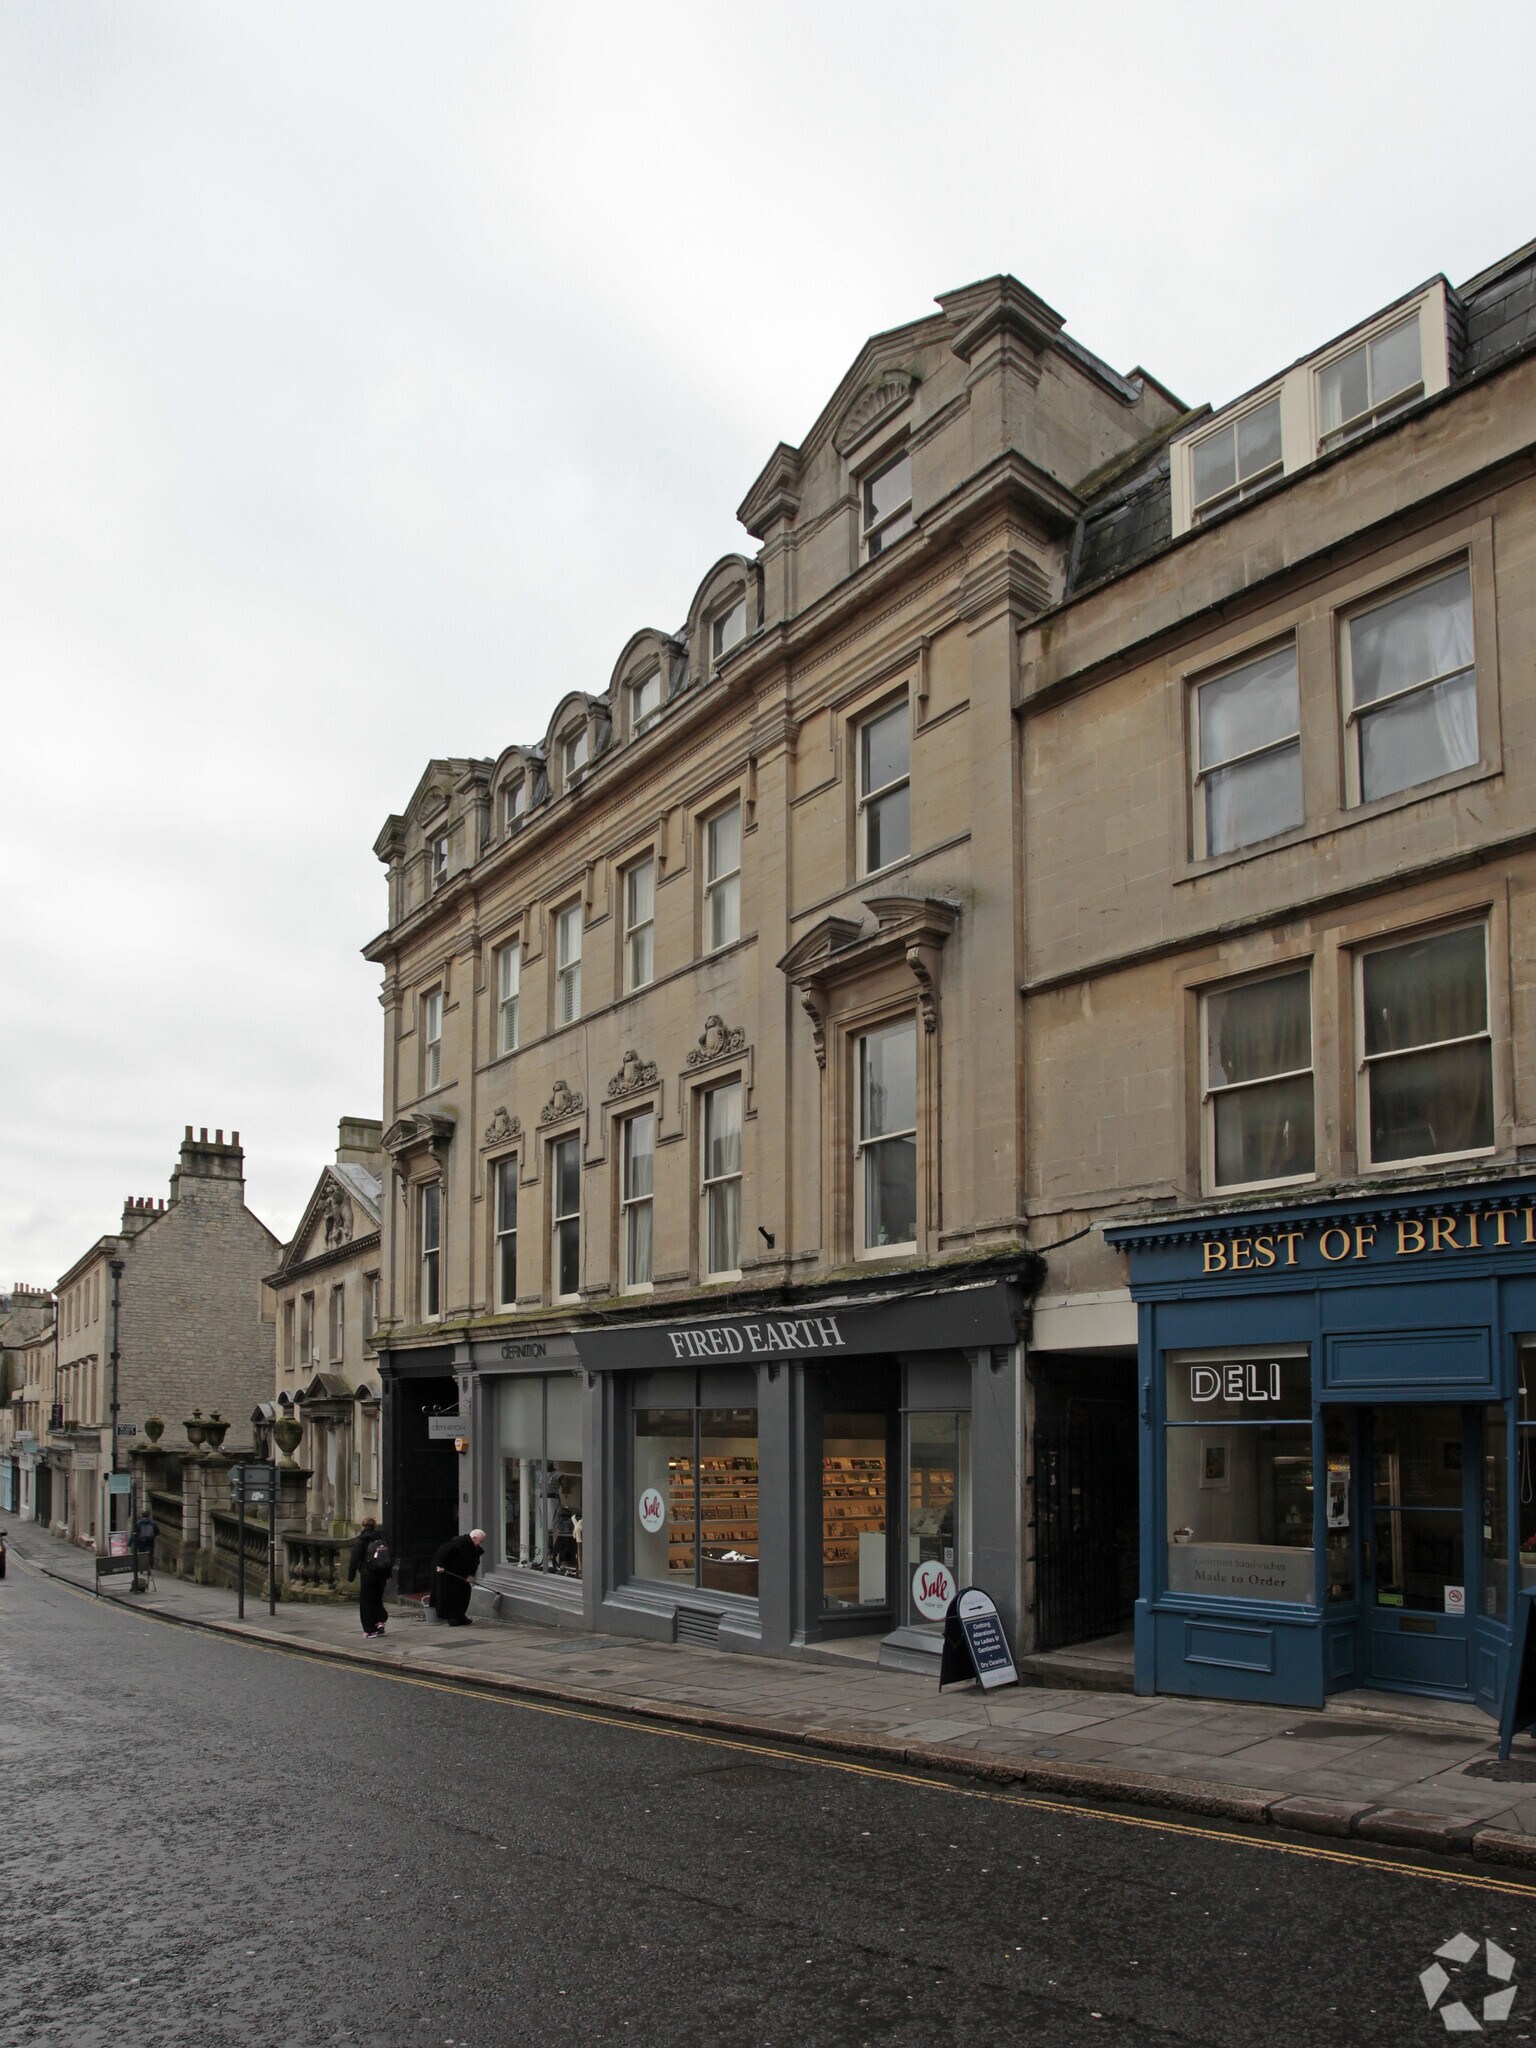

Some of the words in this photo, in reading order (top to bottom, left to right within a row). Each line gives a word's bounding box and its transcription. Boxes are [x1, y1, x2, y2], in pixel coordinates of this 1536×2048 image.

[1202, 1232, 1304, 1273] BEST
[1319, 1224, 1378, 1261] OF
[1395, 1207, 1536, 1255] BRITI
[667, 1327, 744, 1358] FIRED
[743, 1316, 846, 1353] EARTH
[1190, 1363, 1281, 1402] DELI
[643, 1496, 660, 1519] Sale
[1194, 1557, 1232, 1567] Gourmet
[1235, 1560, 1287, 1571] Sandwiches
[919, 1571, 949, 1601] Sale
[1194, 1569, 1227, 1582] Made
[1231, 1575, 1244, 1584] to
[1248, 1574, 1287, 1587] Order
[972, 1622, 991, 1630] Clothing
[973, 1629, 996, 1638] Alterations
[977, 1644, 1001, 1654] Gentlemen
[981, 1637, 994, 1645] Ladies
[980, 1661, 989, 1669] Dry
[989, 1657, 1007, 1666] Cleaning
